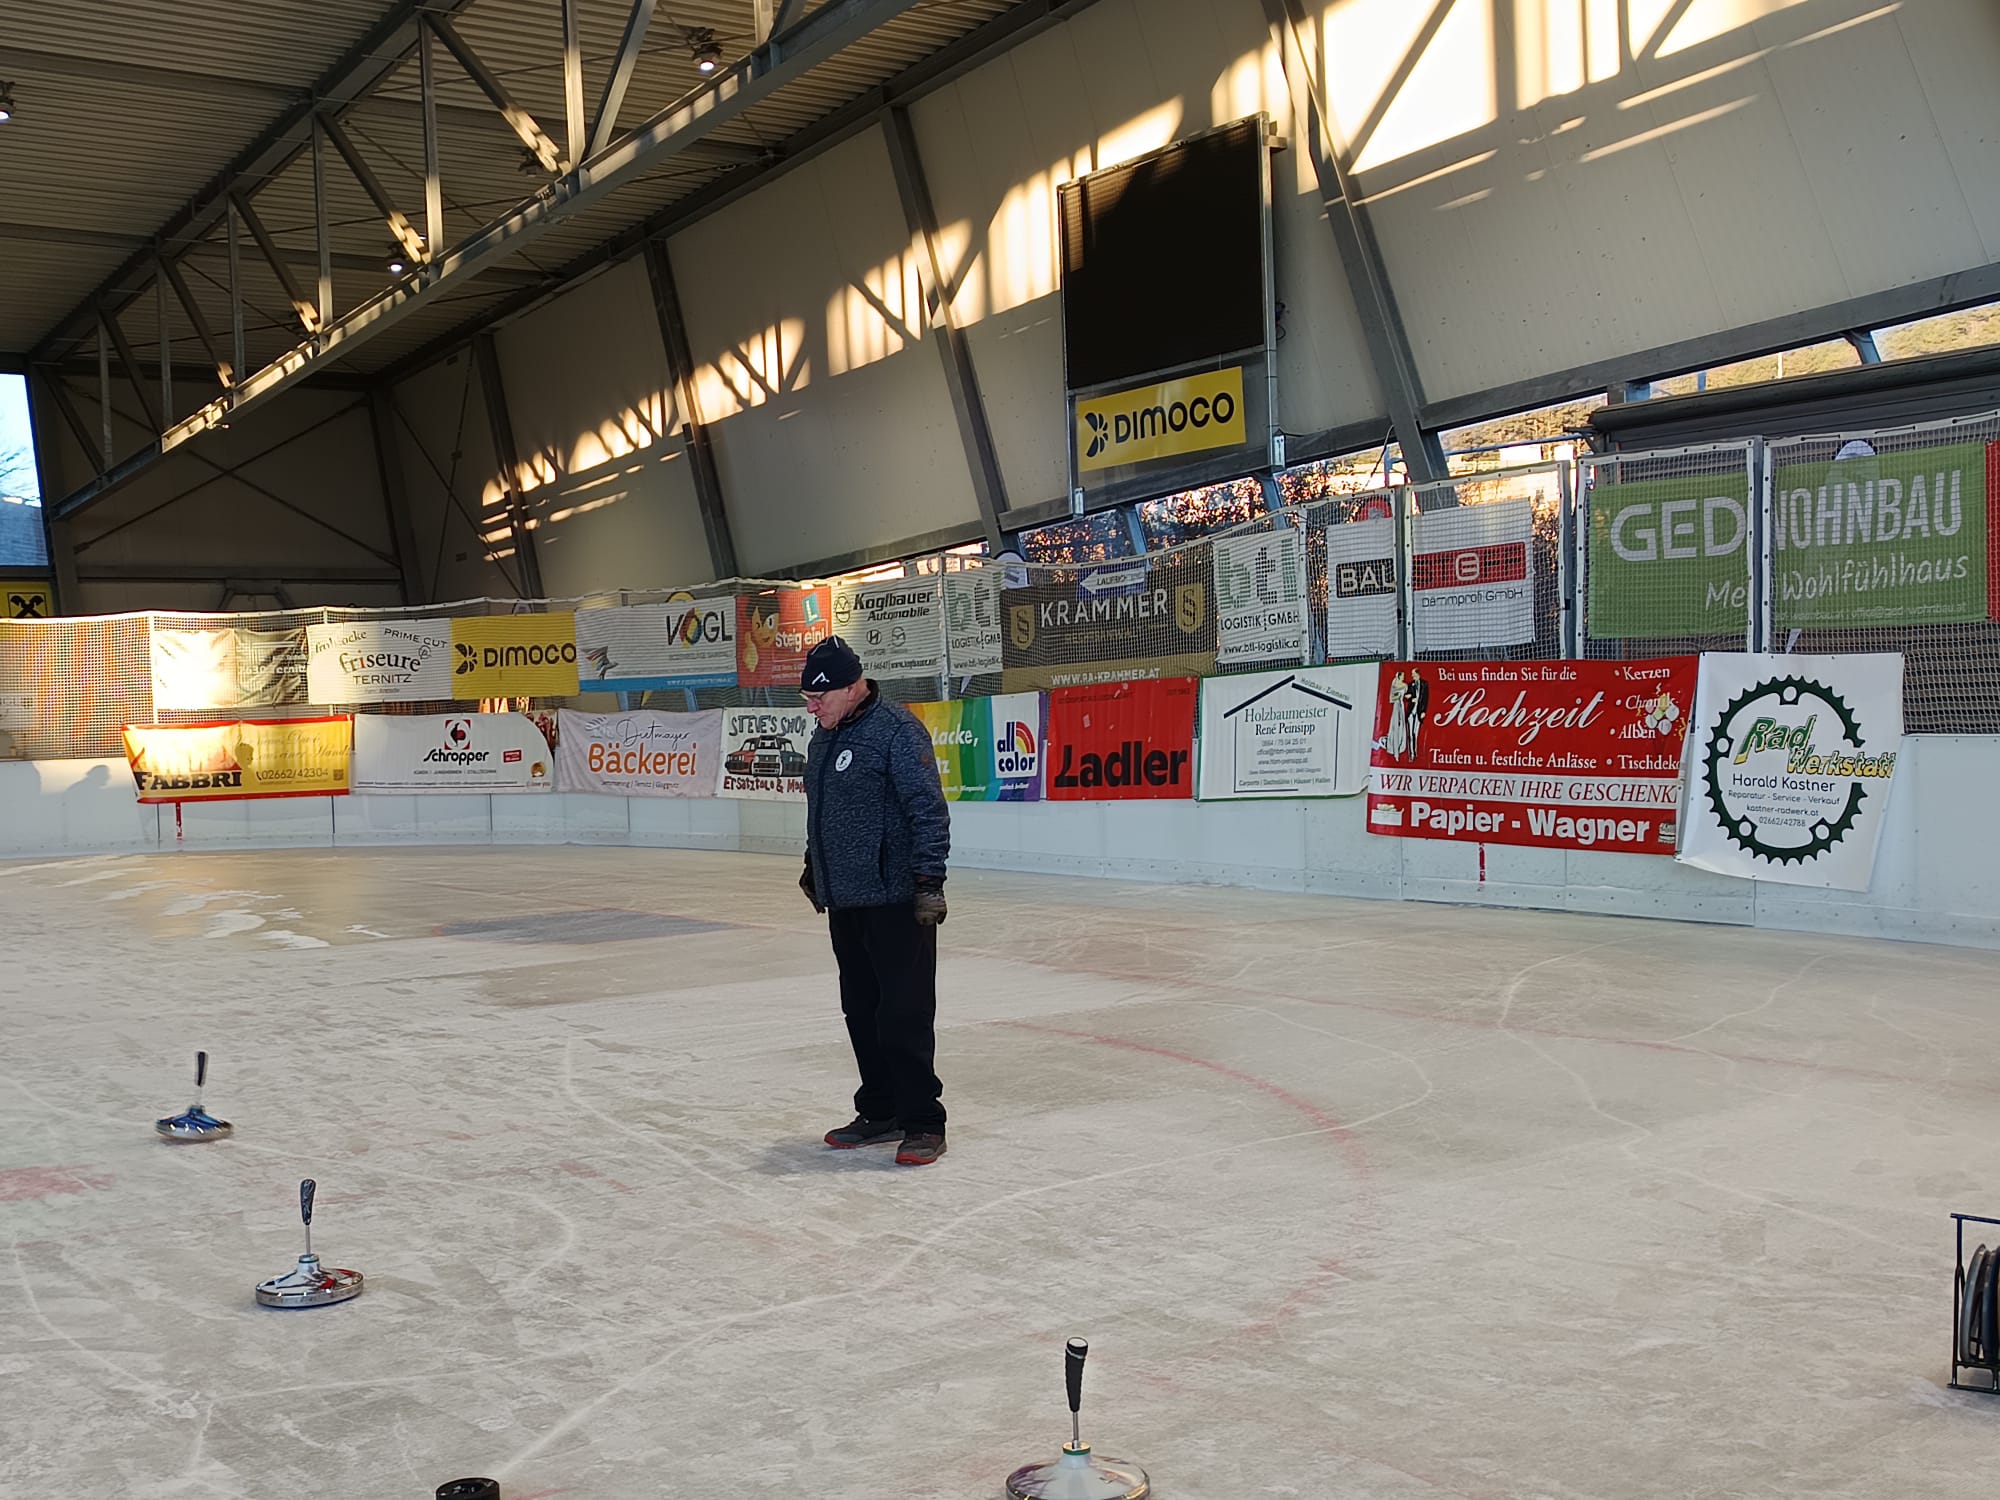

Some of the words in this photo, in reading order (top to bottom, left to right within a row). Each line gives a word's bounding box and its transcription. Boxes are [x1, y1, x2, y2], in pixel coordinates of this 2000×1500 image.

[1115, 392, 1235, 444] DIMOCO
[1610, 496, 1747, 562] GED
[1783, 551, 1969, 602] Wohlfühlhaus
[853, 590, 934, 612] Koglbauer
[1486, 587, 1524, 604] GmbH
[805, 599, 818, 622] L
[867, 606, 930, 622] Automobile
[1040, 588, 1168, 628] KRAMMER
[1221, 614, 1262, 631] LOGISTIK
[1268, 611, 1300, 626] GMBH
[384, 627, 420, 643] PRIME
[423, 637, 448, 649] CUT
[984, 632, 1001, 645] GMB
[339, 649, 421, 674] friseure
[484, 642, 577, 668] DIMOCO
[353, 673, 412, 685] TERNITZ
[1437, 667, 1455, 681] Bei
[1458, 670, 1478, 681] uns
[1481, 667, 1518, 681] finden
[1521, 667, 1538, 681] Sie
[1540, 667, 1557, 681] für
[1559, 667, 1577, 681] die
[1622, 666, 1670, 680] Kerzen
[1244, 704, 1329, 723] Holzbaumeister
[1433, 687, 1605, 745] Hochzeit
[997, 721, 1015, 753] all
[1255, 722, 1276, 736] René
[1279, 720, 1316, 736] Peinsipp
[1617, 722, 1656, 739] Alben
[1733, 714, 1818, 765] Rad
[423, 748, 490, 766] Schropper
[588, 742, 697, 776] Bäckerei
[998, 751, 1036, 772] color
[1054, 740, 1188, 789] Ladler
[1429, 747, 1471, 765] Taufen
[1475, 752, 1487, 766] u.
[1491, 750, 1543, 768] festliche
[1546, 752, 1597, 769] Anlässe
[1786, 744, 1897, 779] Werkstatt
[135, 771, 243, 791] FABBRI
[1380, 772, 1412, 792] WIR
[1418, 775, 1514, 798] VERPACKEN
[1520, 778, 1562, 800] IHRE
[1568, 781, 1677, 804] GESCHENK
[1732, 773, 1778, 789] Harald
[1782, 776, 1836, 792] Kastner
[1728, 789, 1766, 800] Reparatur
[1772, 792, 1801, 803] Service
[1808, 795, 1840, 805] Verkauf
[1746, 802, 1819, 817] kastner-radwerk.at
[1410, 801, 1504, 837] Papier
[1527, 806, 1650, 846] Wagner
